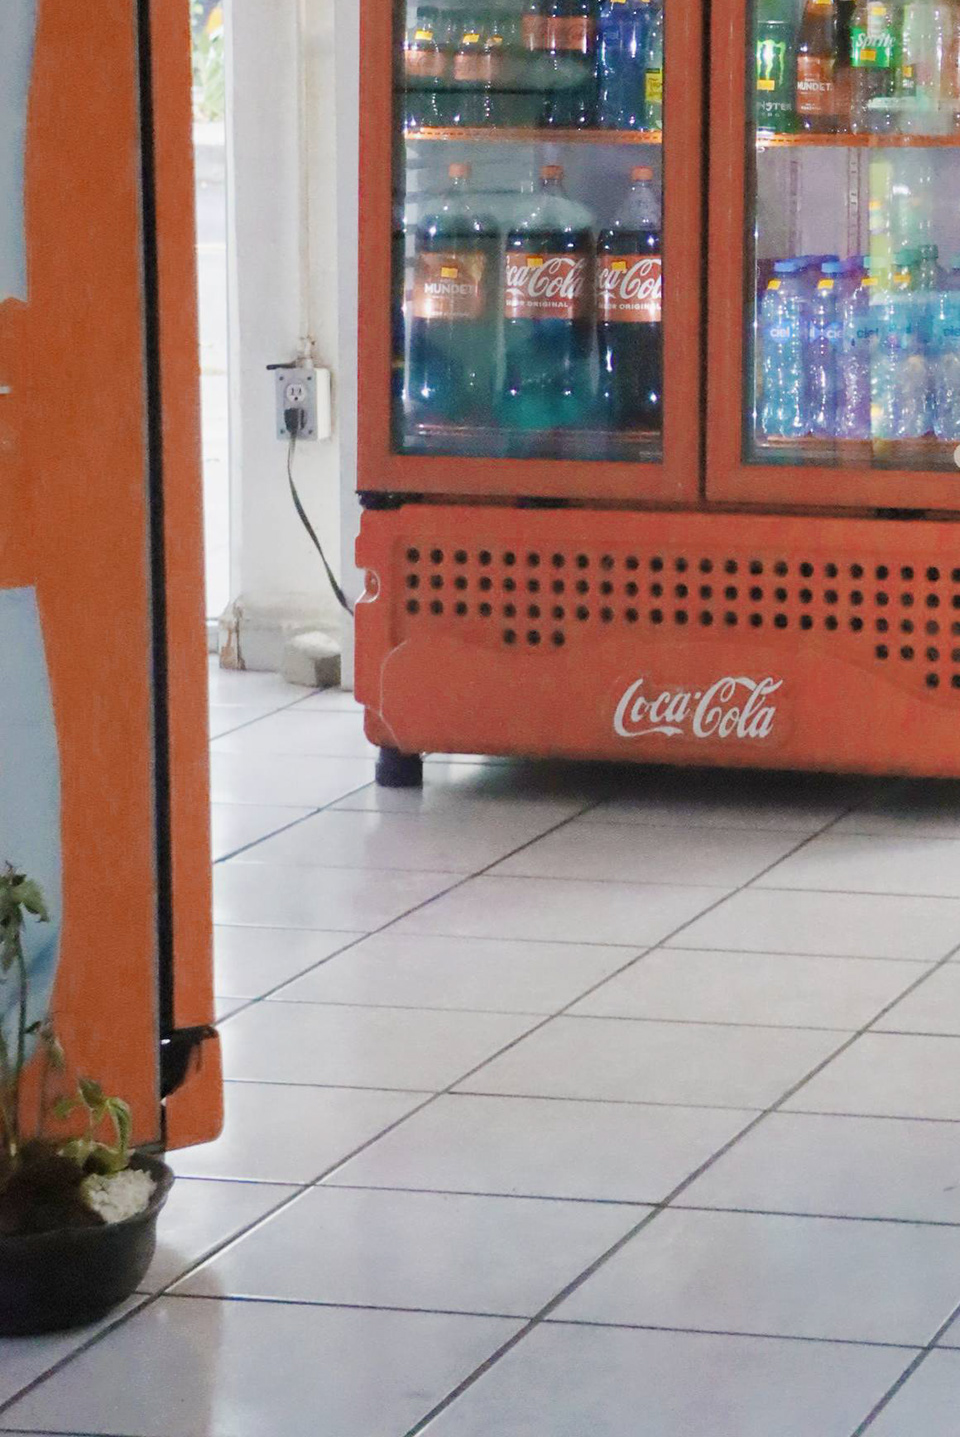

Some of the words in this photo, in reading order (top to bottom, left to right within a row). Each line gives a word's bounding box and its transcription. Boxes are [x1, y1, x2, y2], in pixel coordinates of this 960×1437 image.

[857, 32, 896, 49] Sprite
[527, 301, 569, 309] ORIGINAL
[613, 676, 784, 739] Coca-Cola
